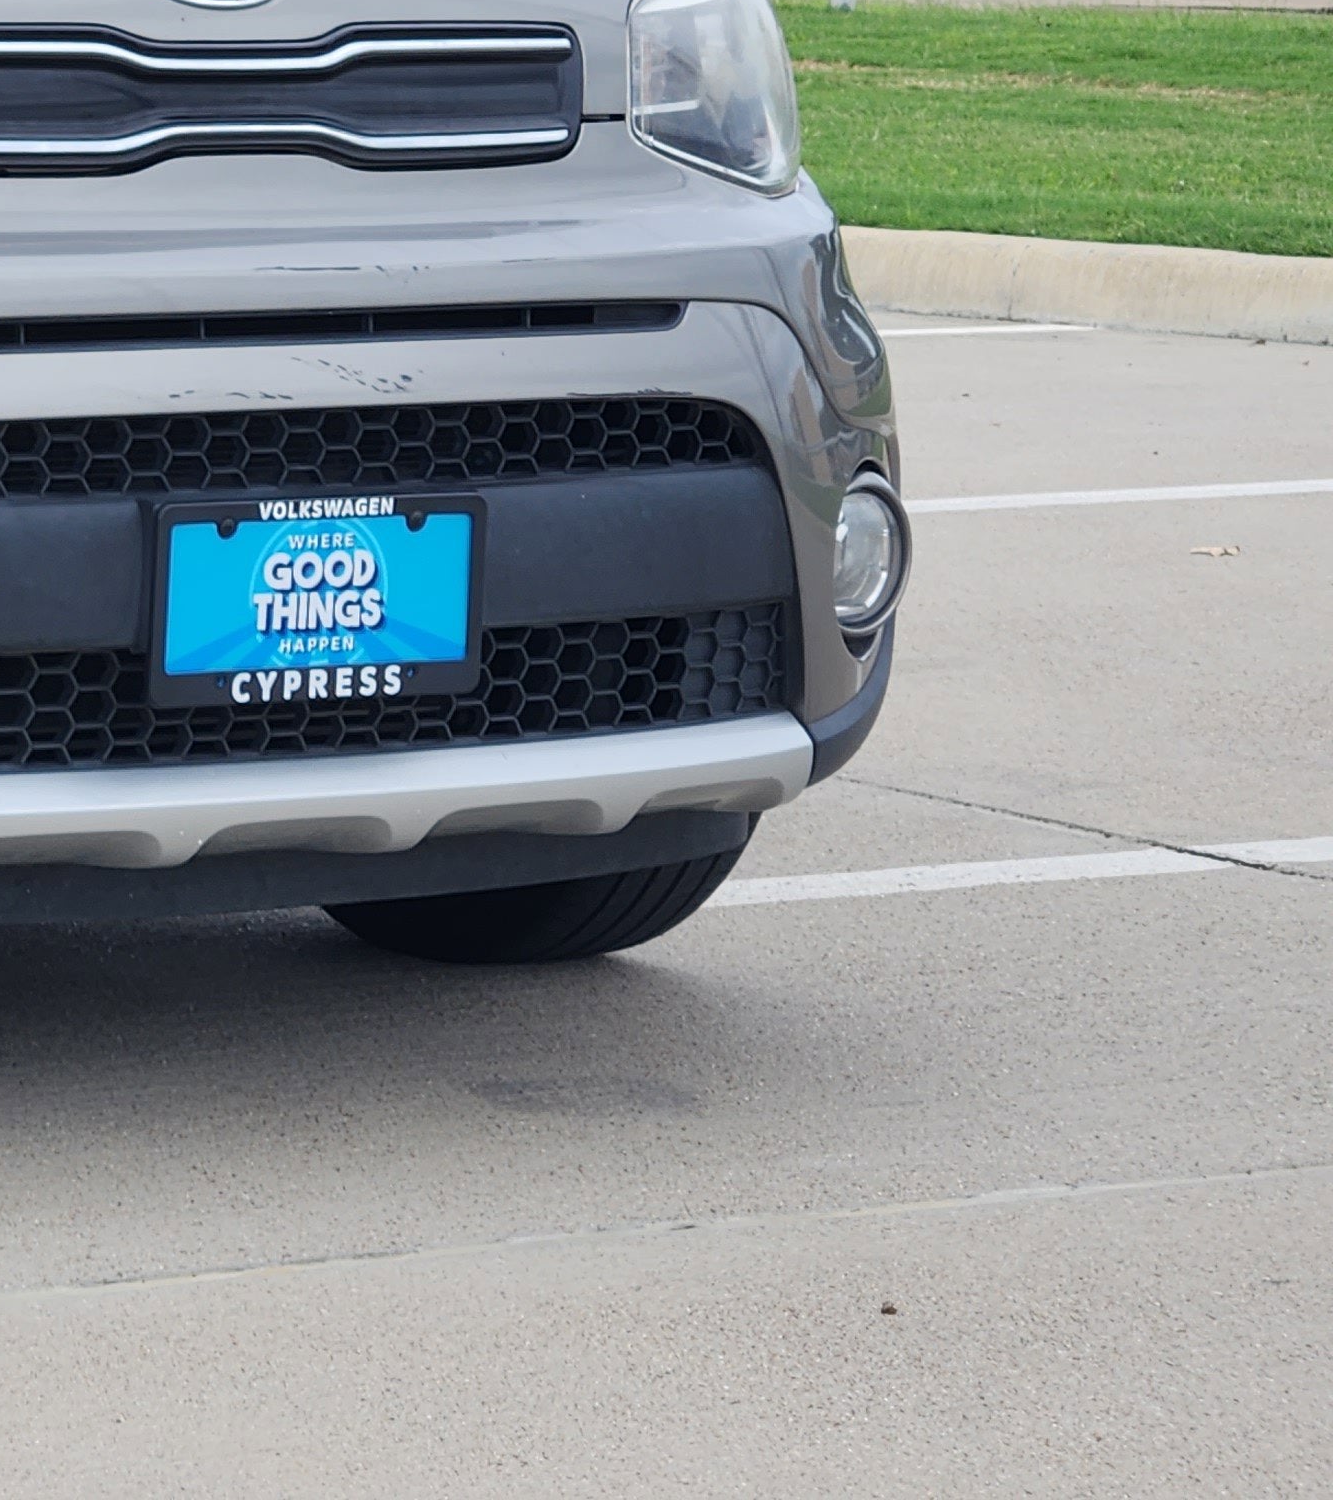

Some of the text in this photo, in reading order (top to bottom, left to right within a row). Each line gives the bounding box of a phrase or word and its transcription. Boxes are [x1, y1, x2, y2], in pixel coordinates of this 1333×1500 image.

[258, 497, 396, 521] VOLKSWAGEN
[288, 532, 355, 550] WHERE
[263, 549, 377, 591] GOOD
[253, 589, 385, 632] THINGS
[278, 636, 355, 654] HAPPEN
[231, 665, 403, 703] CYPRESS
